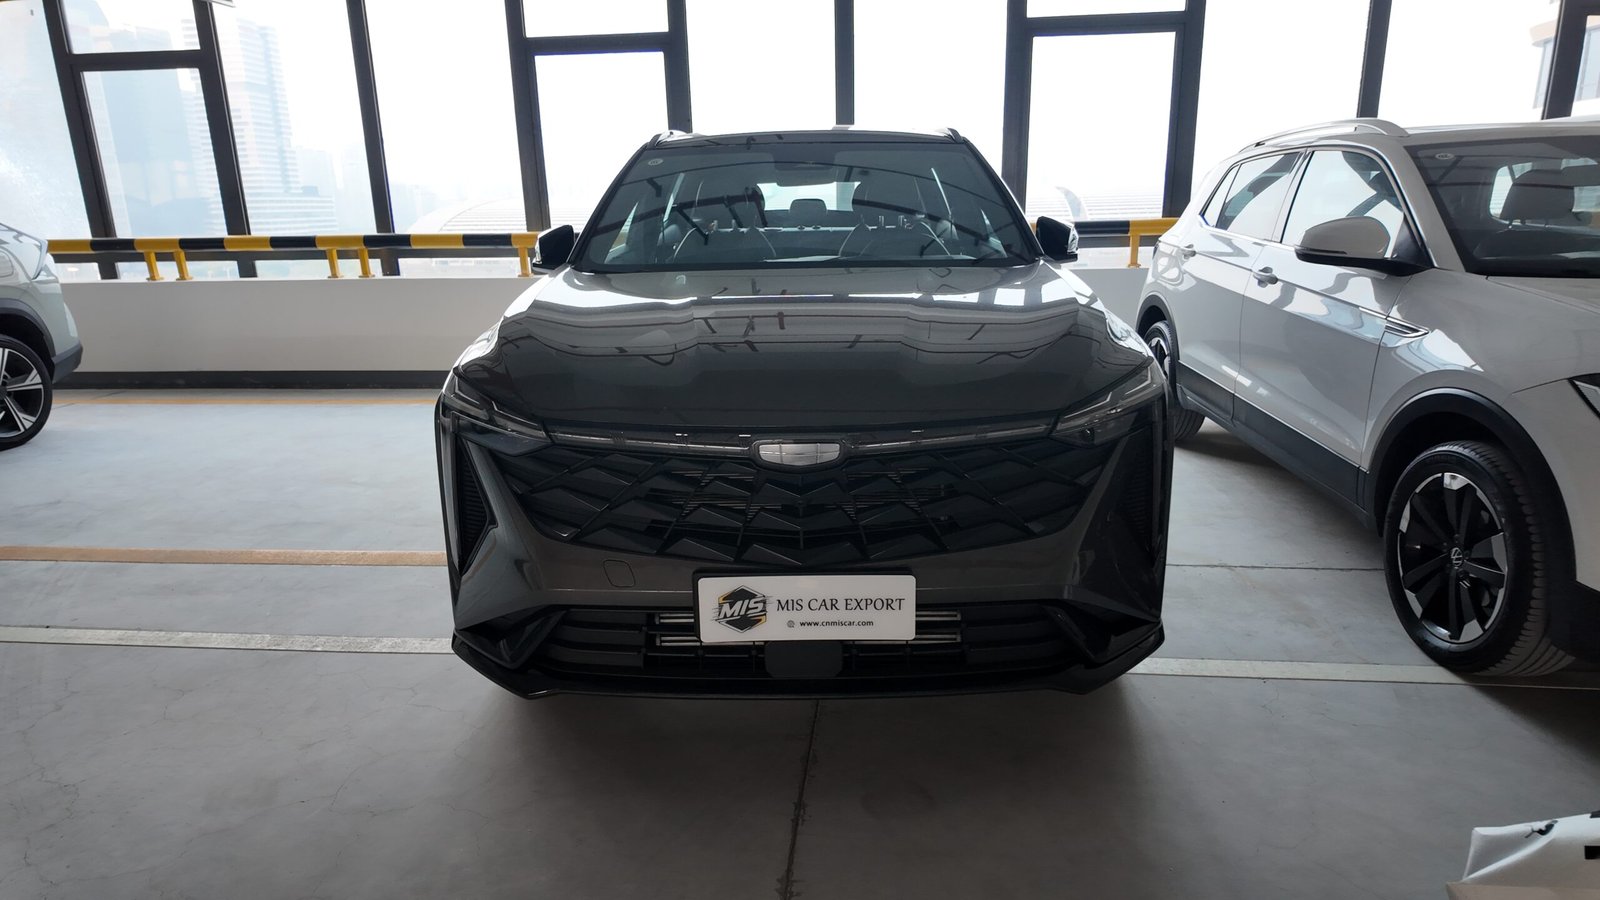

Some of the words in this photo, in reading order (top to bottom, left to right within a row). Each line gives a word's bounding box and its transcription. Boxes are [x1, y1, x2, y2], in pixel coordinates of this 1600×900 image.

[719, 597, 766, 619] MIS
[776, 598, 804, 611] MIS
[807, 598, 840, 611] CAR
[844, 597, 906, 611] EXPORT
